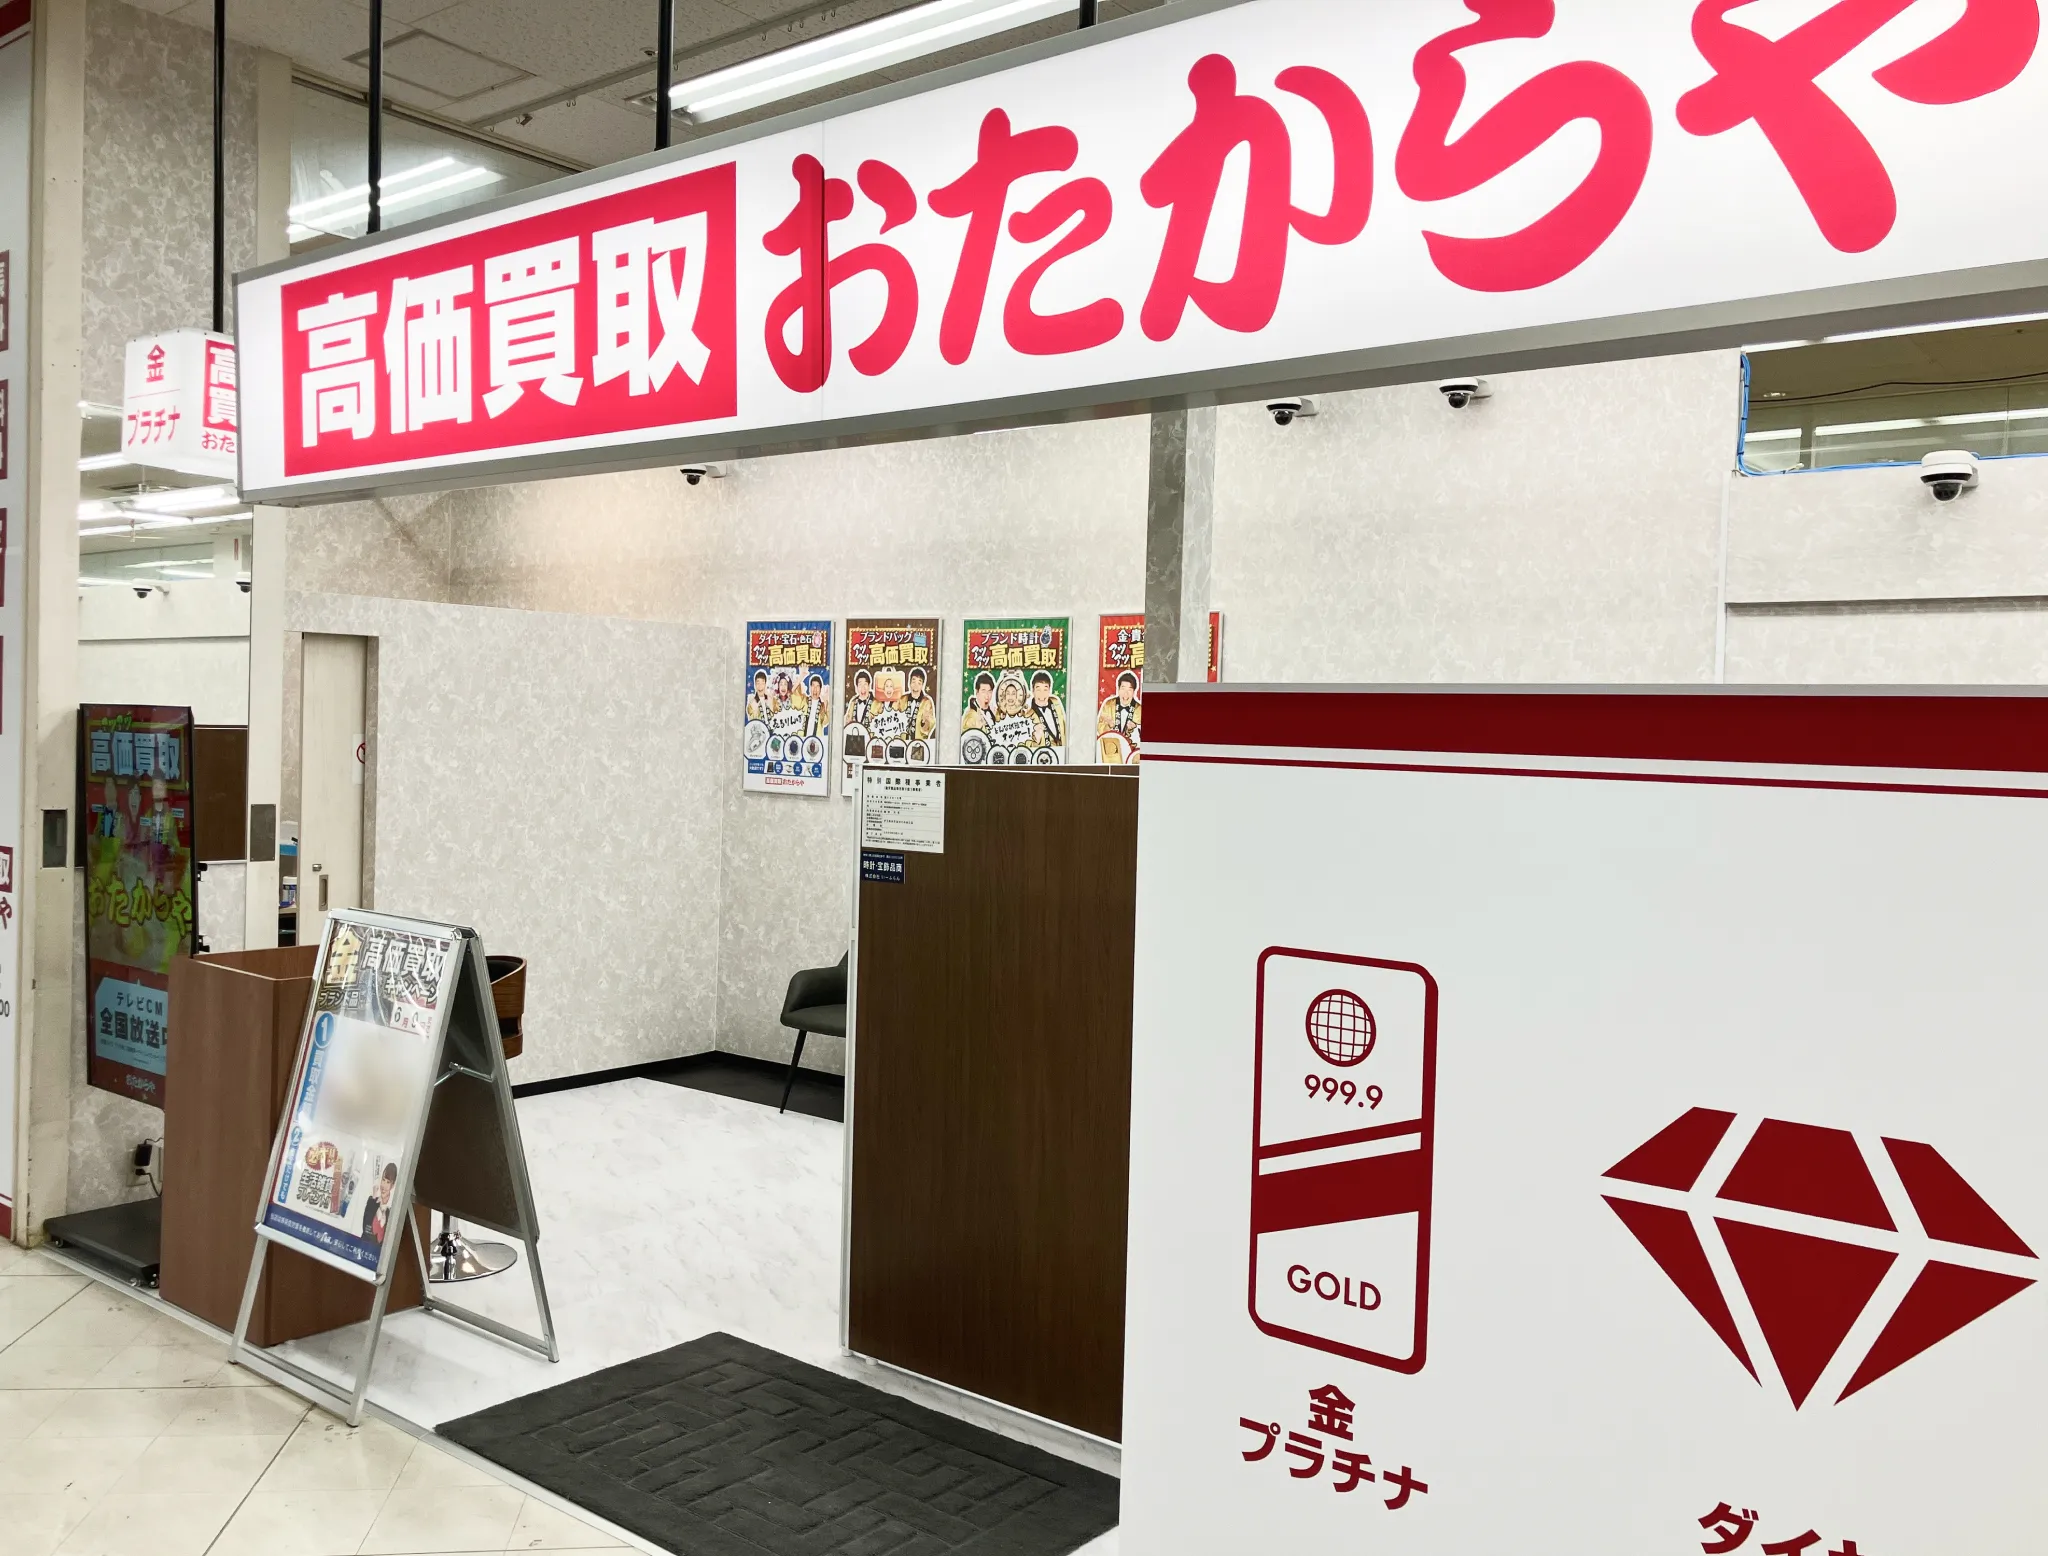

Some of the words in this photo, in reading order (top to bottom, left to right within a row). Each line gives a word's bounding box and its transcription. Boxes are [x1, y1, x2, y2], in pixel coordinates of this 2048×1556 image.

[297, 211, 711, 448] 高価買取
[763, 0, 2040, 393] おたからや
[146, 344, 166, 383] 金
[127, 405, 181, 447] プラチナ
[768, 644, 822, 667] 高価買取
[860, 631, 913, 643] ブランドバッグ
[868, 642, 929, 666] 高価買取
[981, 631, 1040, 645] ブランド時計
[1117, 628, 1145, 643] 金・貴
[989, 643, 1057, 669] 高価買取
[90, 729, 181, 780] 高価買取
[88, 874, 192, 938] おたからや
[326, 925, 362, 985] 金
[361, 933, 447, 983] 高価買取
[116, 991, 163, 1017] テレビCM
[1304, 1074, 1383, 1110] 999.9
[1286, 1263, 1382, 1311] GOLD
[1307, 1383, 1356, 1442] 金
[1239, 1415, 1429, 1511] プラチナ
